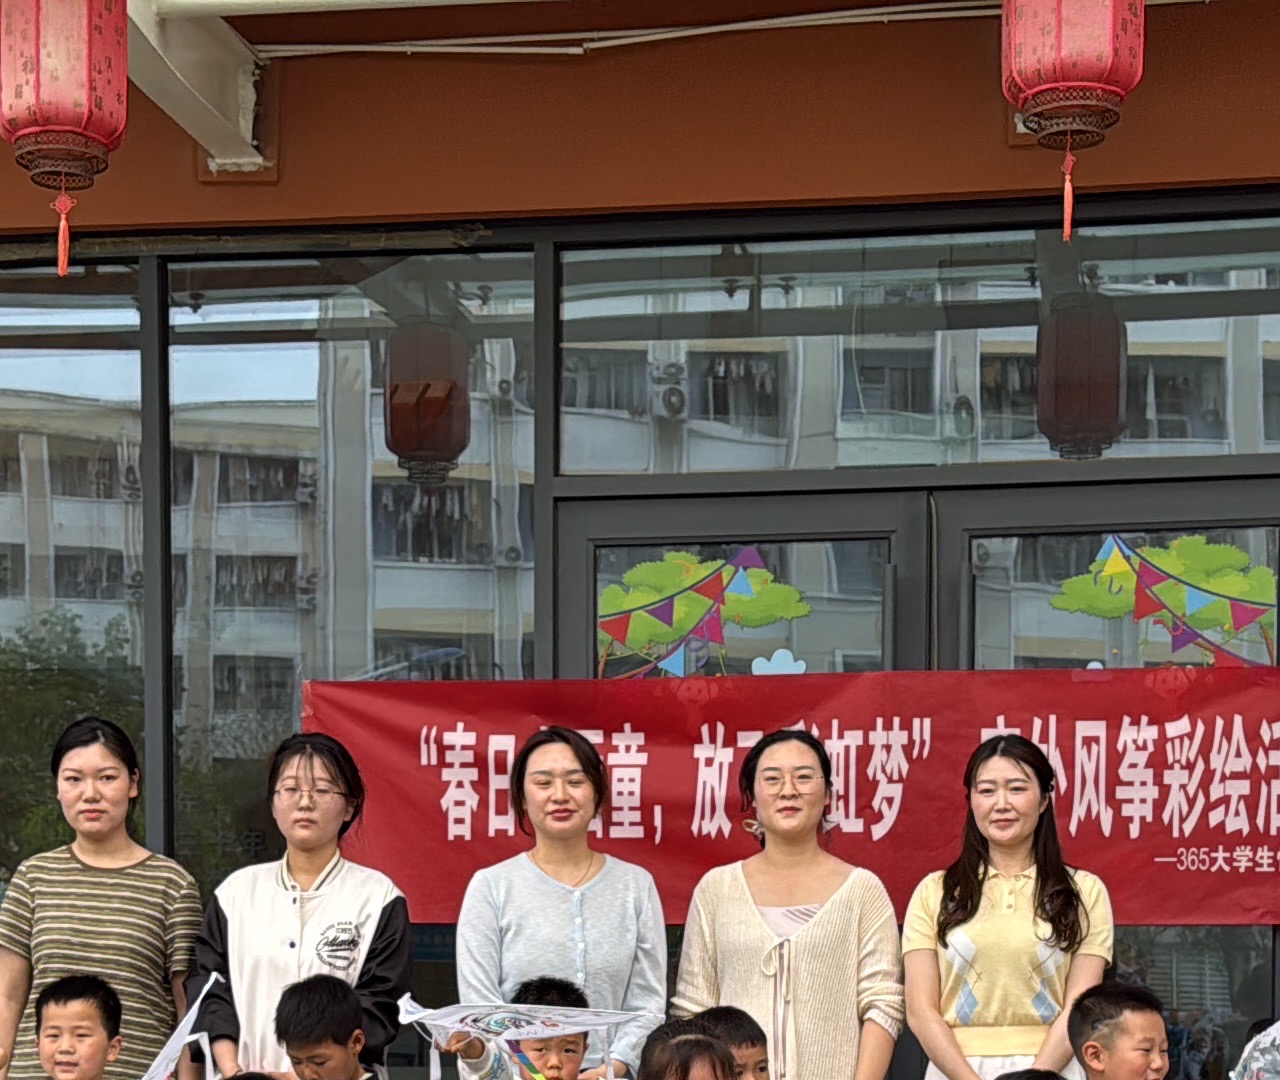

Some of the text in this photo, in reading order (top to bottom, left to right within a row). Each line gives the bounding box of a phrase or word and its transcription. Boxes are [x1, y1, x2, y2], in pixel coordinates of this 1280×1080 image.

[420, 716, 932, 846] “春日童，放虹梦”
